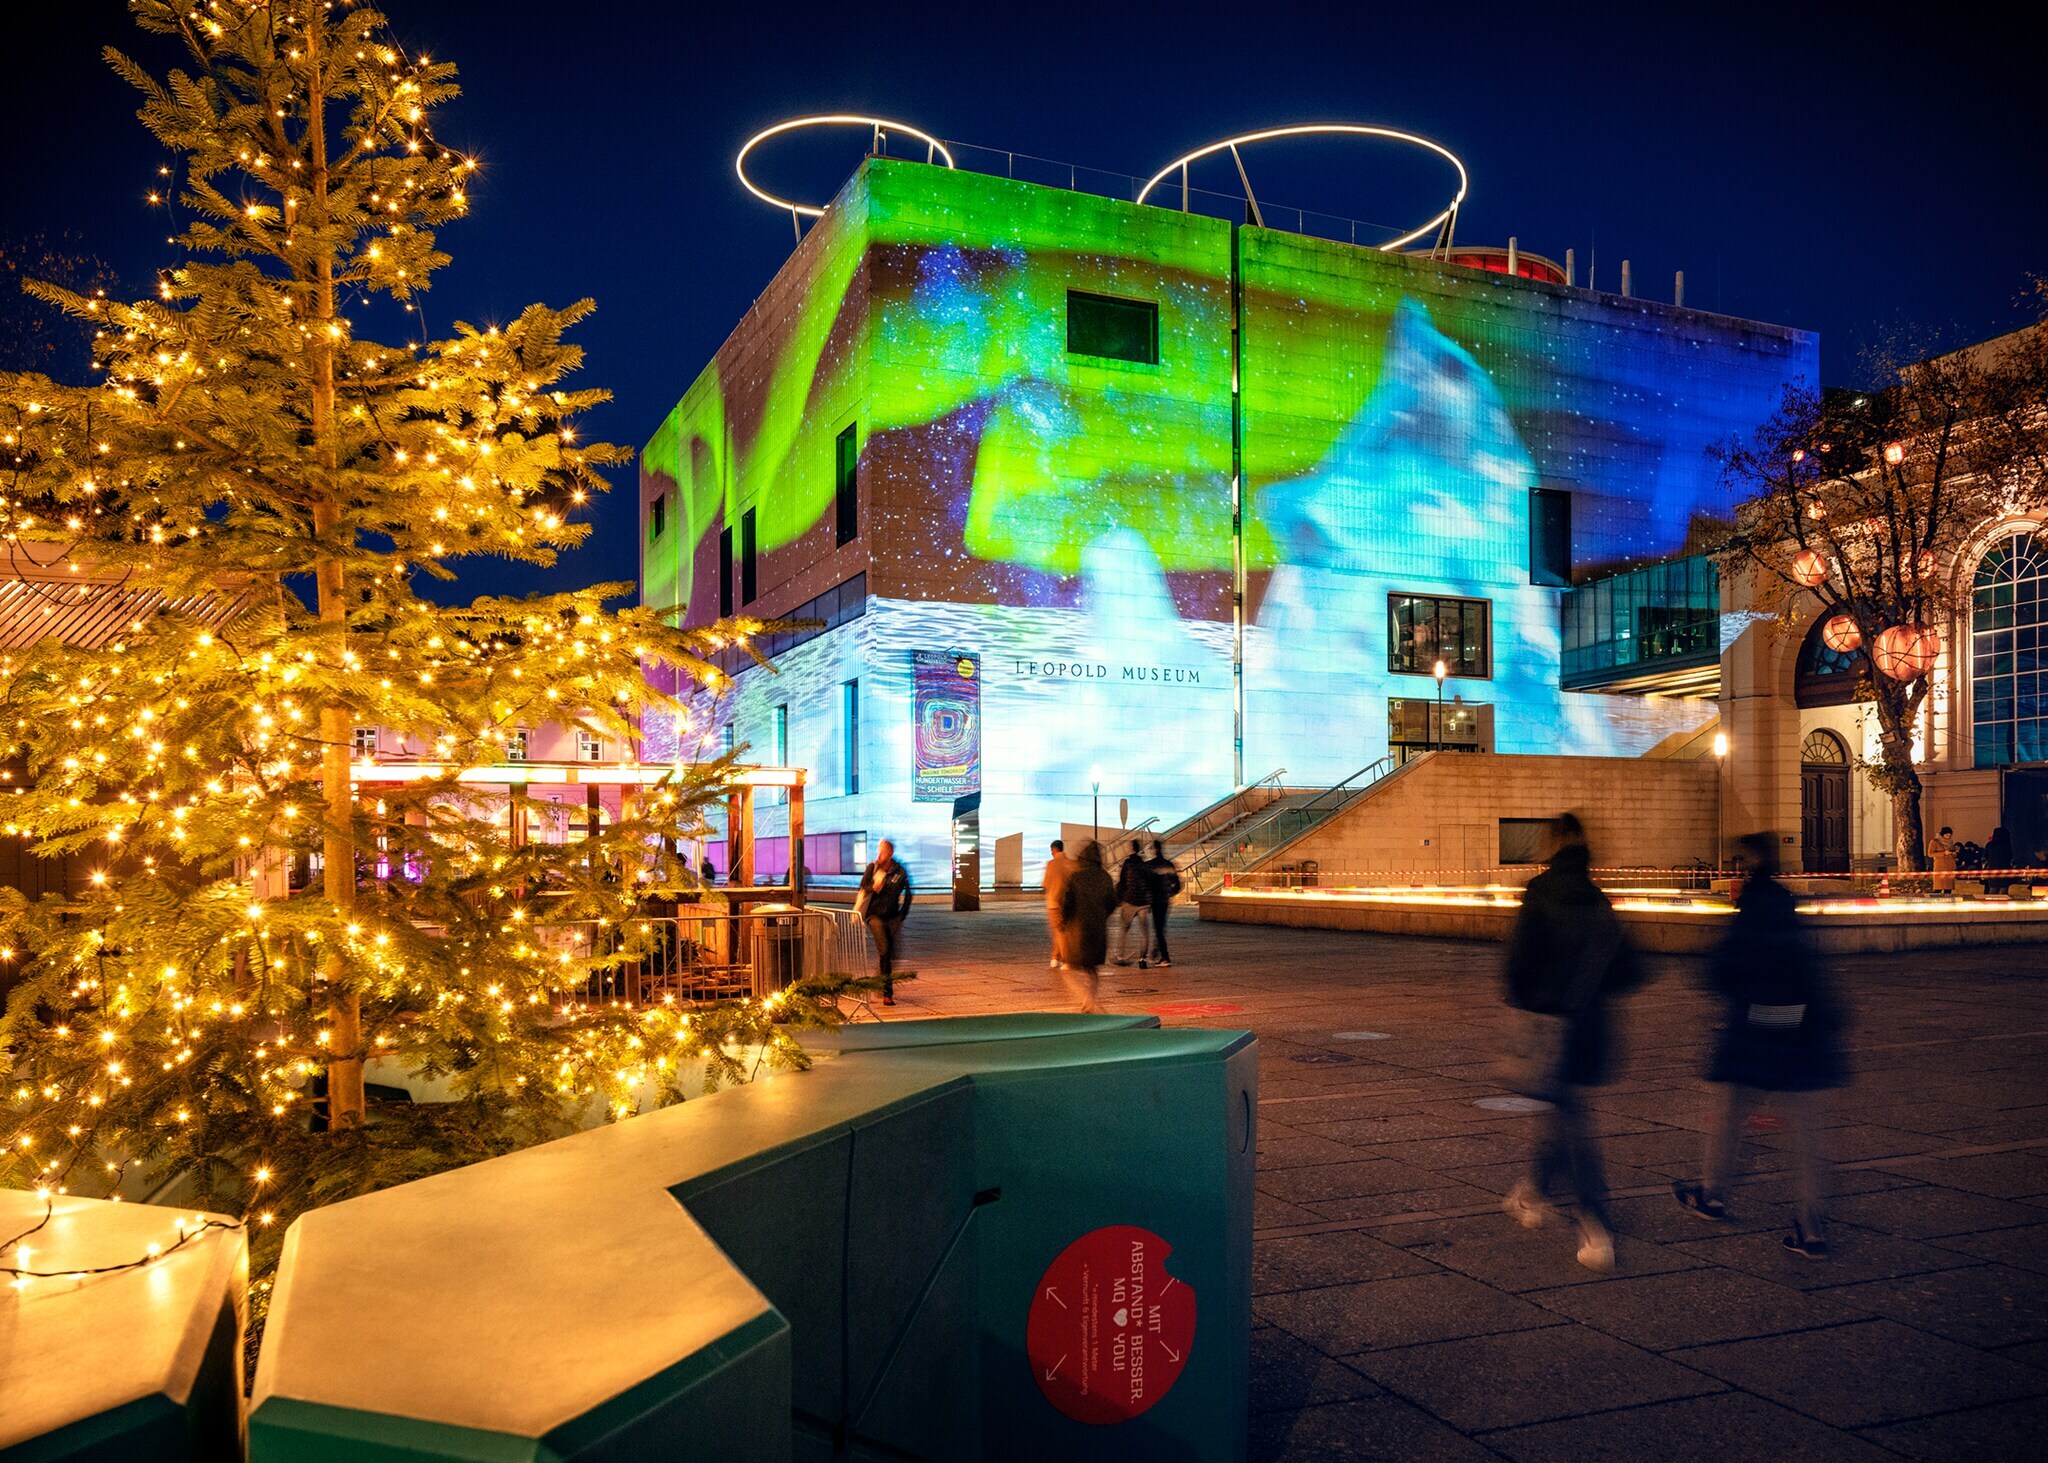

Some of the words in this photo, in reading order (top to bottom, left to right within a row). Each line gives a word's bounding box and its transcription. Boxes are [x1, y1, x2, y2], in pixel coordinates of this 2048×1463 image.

[1016, 660, 1107, 678] LEOPOLD
[1122, 666, 1200, 683] MUSEUM
[926, 785, 953, 793] SCHIELE
[1082, 1270, 1090, 1305] Vernunft
[1112, 1277, 1126, 1303] MQ
[1149, 1305, 1161, 1334] MIT
[1080, 1315, 1090, 1396] Eigenverantwortung
[1091, 1347, 1099, 1372] Meter
[1113, 1333, 1126, 1372] YOU!
[1131, 1335, 1144, 1404] BESSER.
